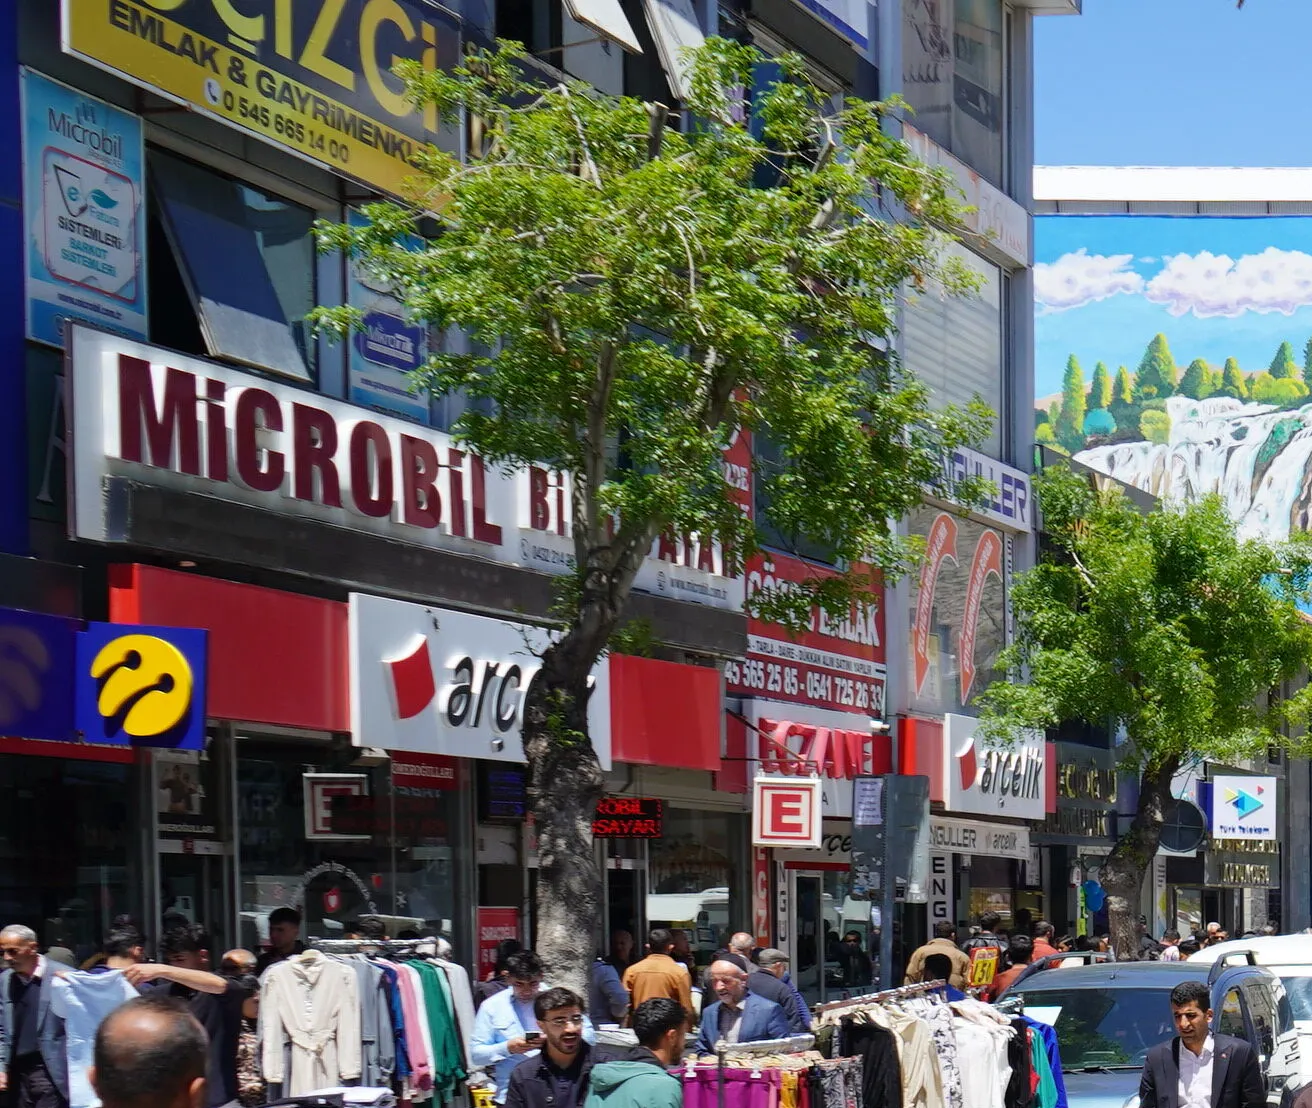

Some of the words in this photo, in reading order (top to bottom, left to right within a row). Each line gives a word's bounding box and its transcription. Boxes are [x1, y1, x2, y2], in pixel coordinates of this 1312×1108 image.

[108, 2, 221, 75] EMLAK
[227, 55, 250, 89] &
[48, 106, 123, 161] Microbil
[222, 90, 235, 112] 0
[238, 98, 270, 129] 545
[273, 115, 306, 143] 665
[308, 129, 325, 151] 14
[329, 138, 350, 165] 00
[742, 659, 765, 690] 565
[767, 663, 782, 693] 25
[784, 666, 799, 695] 85
[806, 671, 832, 702] 0541
[834, 676, 854, 706] 725
[855, 681, 869, 709] 26
[870, 684, 882, 711] 33
[770, 793, 803, 832] E
[1219, 825, 1236, 834] Türk
[1238, 825, 1270, 834] Telekom
